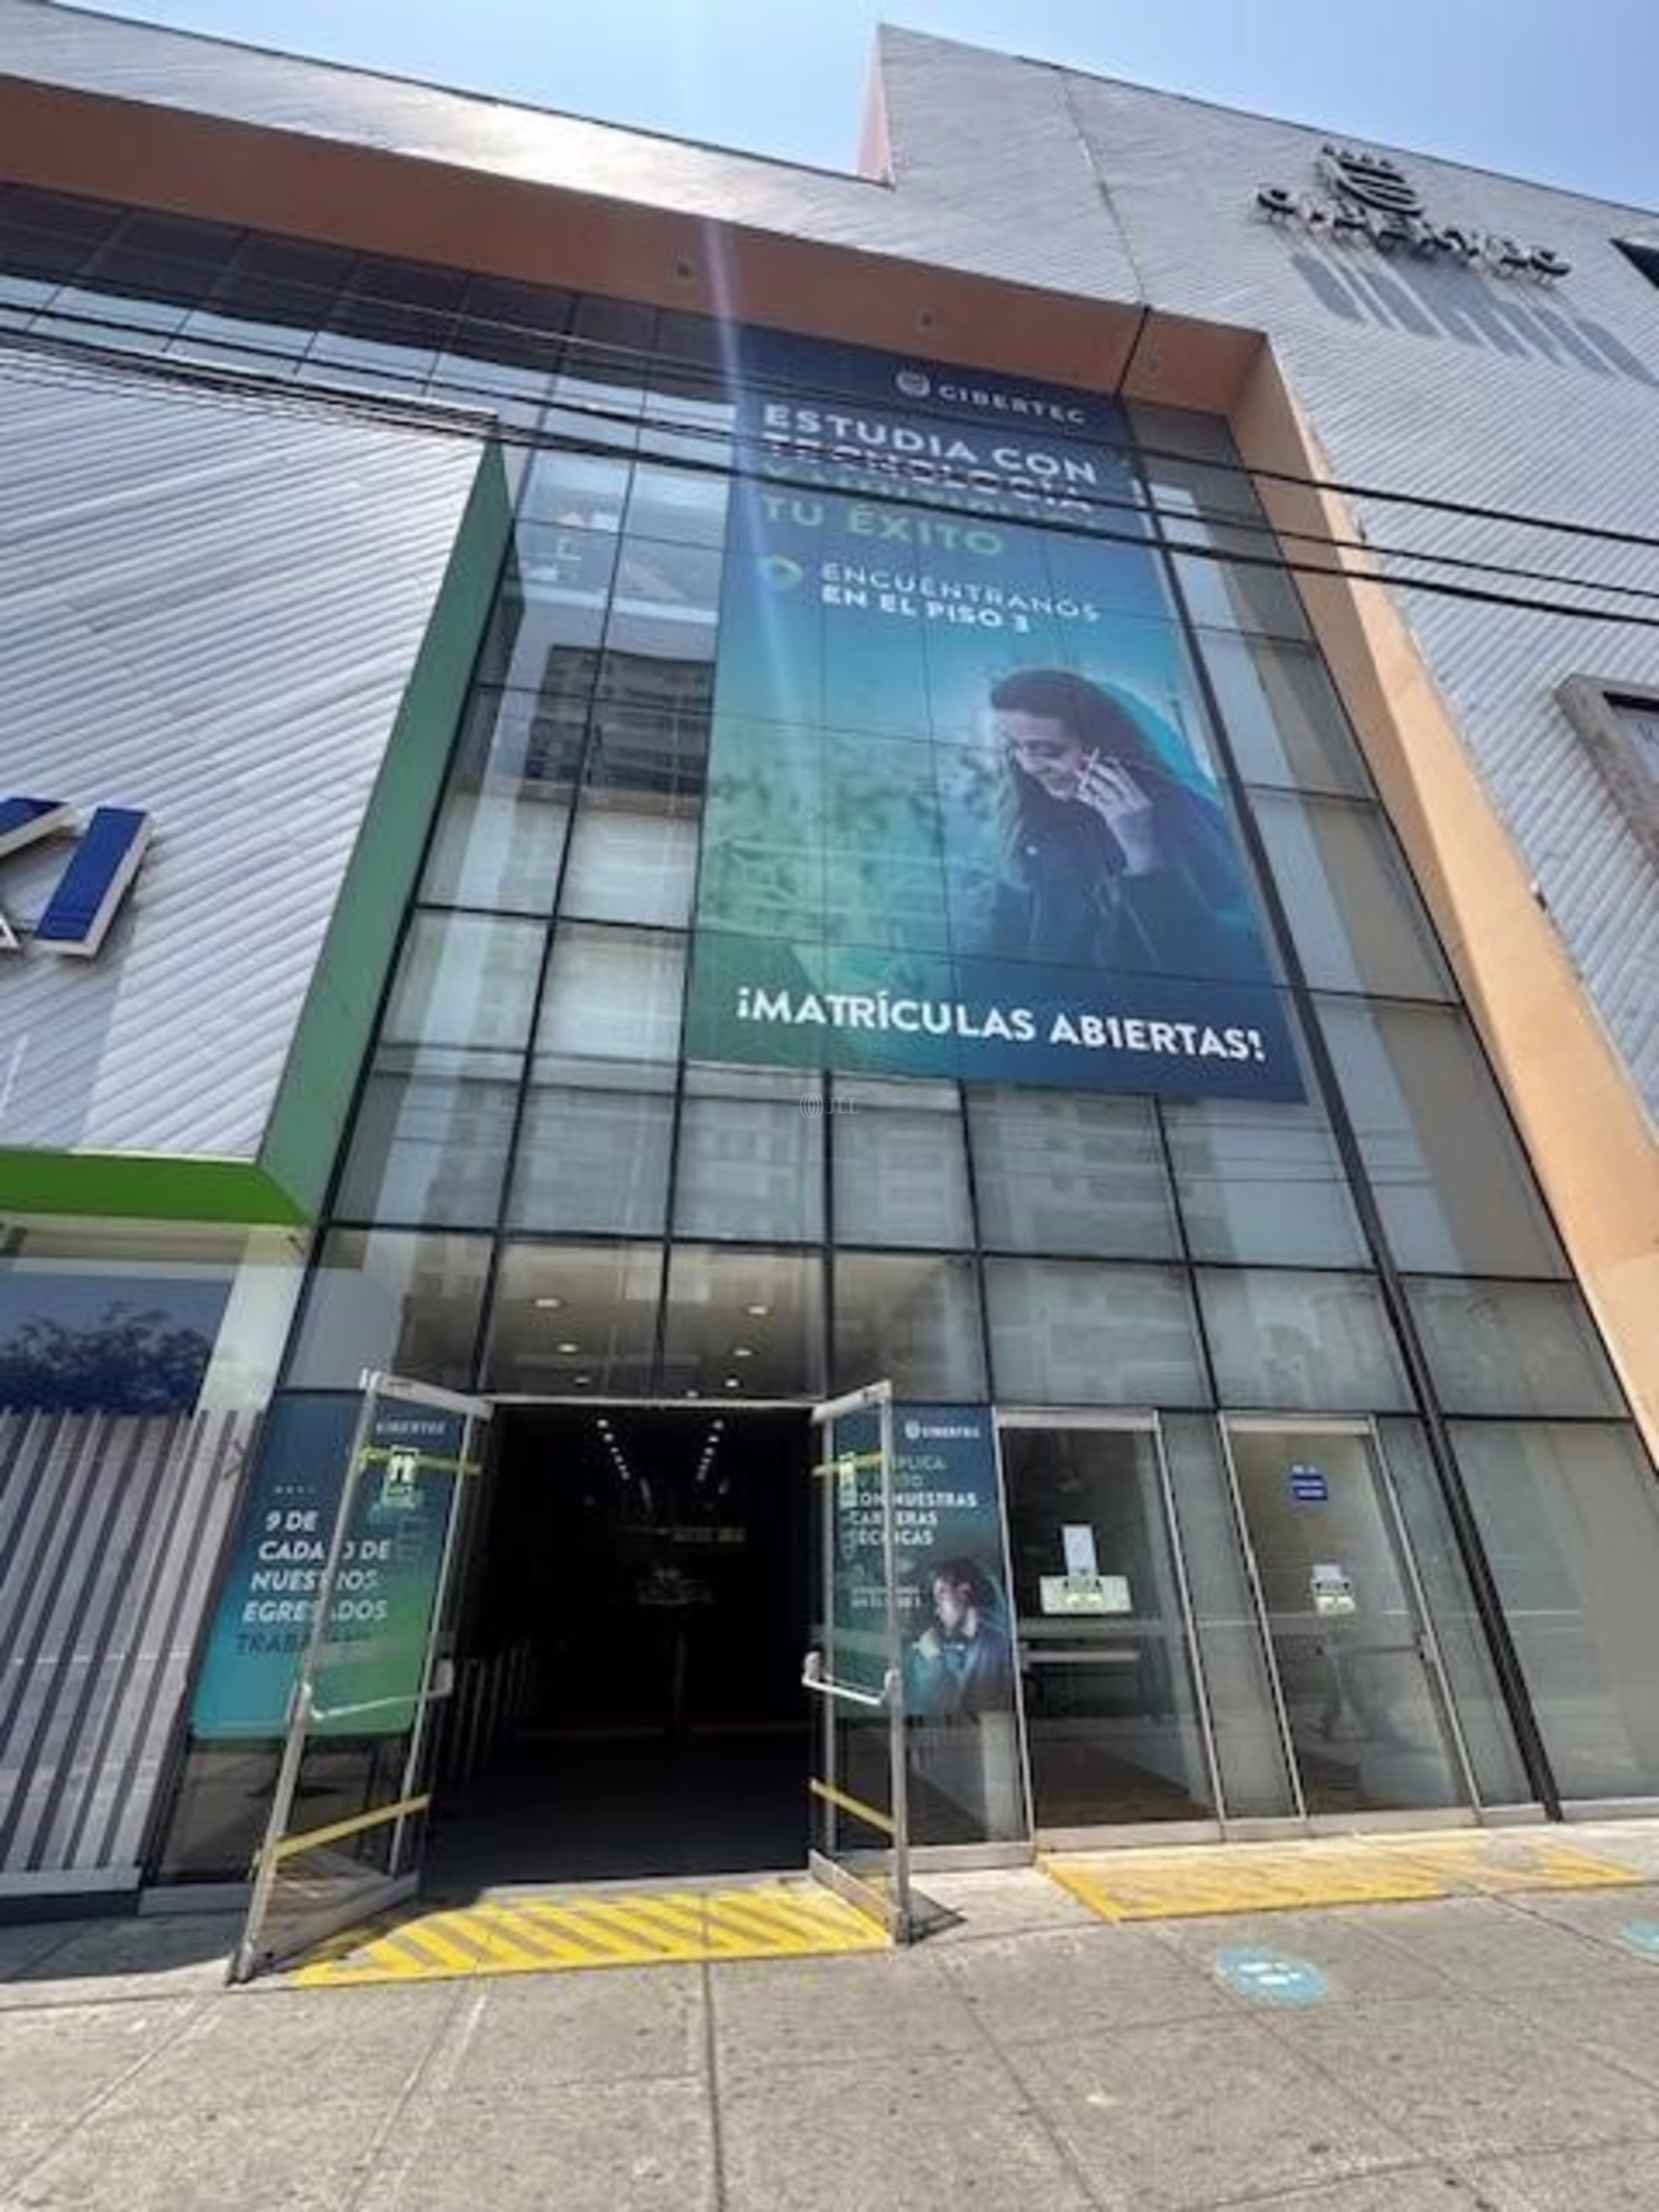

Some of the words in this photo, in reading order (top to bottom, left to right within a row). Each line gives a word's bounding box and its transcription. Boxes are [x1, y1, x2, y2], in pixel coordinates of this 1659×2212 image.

[939, 386, 1085, 424] CIBERTEC
[764, 403, 978, 463] ESTUDIA
[992, 447, 1097, 485] CON
[765, 493, 823, 527] TU
[822, 585, 867, 608] EN
[880, 593, 916, 617] EL
[928, 601, 1002, 627] PISO
[737, 988, 1035, 1042] ¡MATRÍCULAS
[1050, 1013, 1267, 1062] ABIERTAS!
[265, 1511, 281, 1532] 9
[285, 1510, 319, 1532] DE
[259, 1540, 324, 1560] CADA
[359, 1539, 390, 1560] DE
